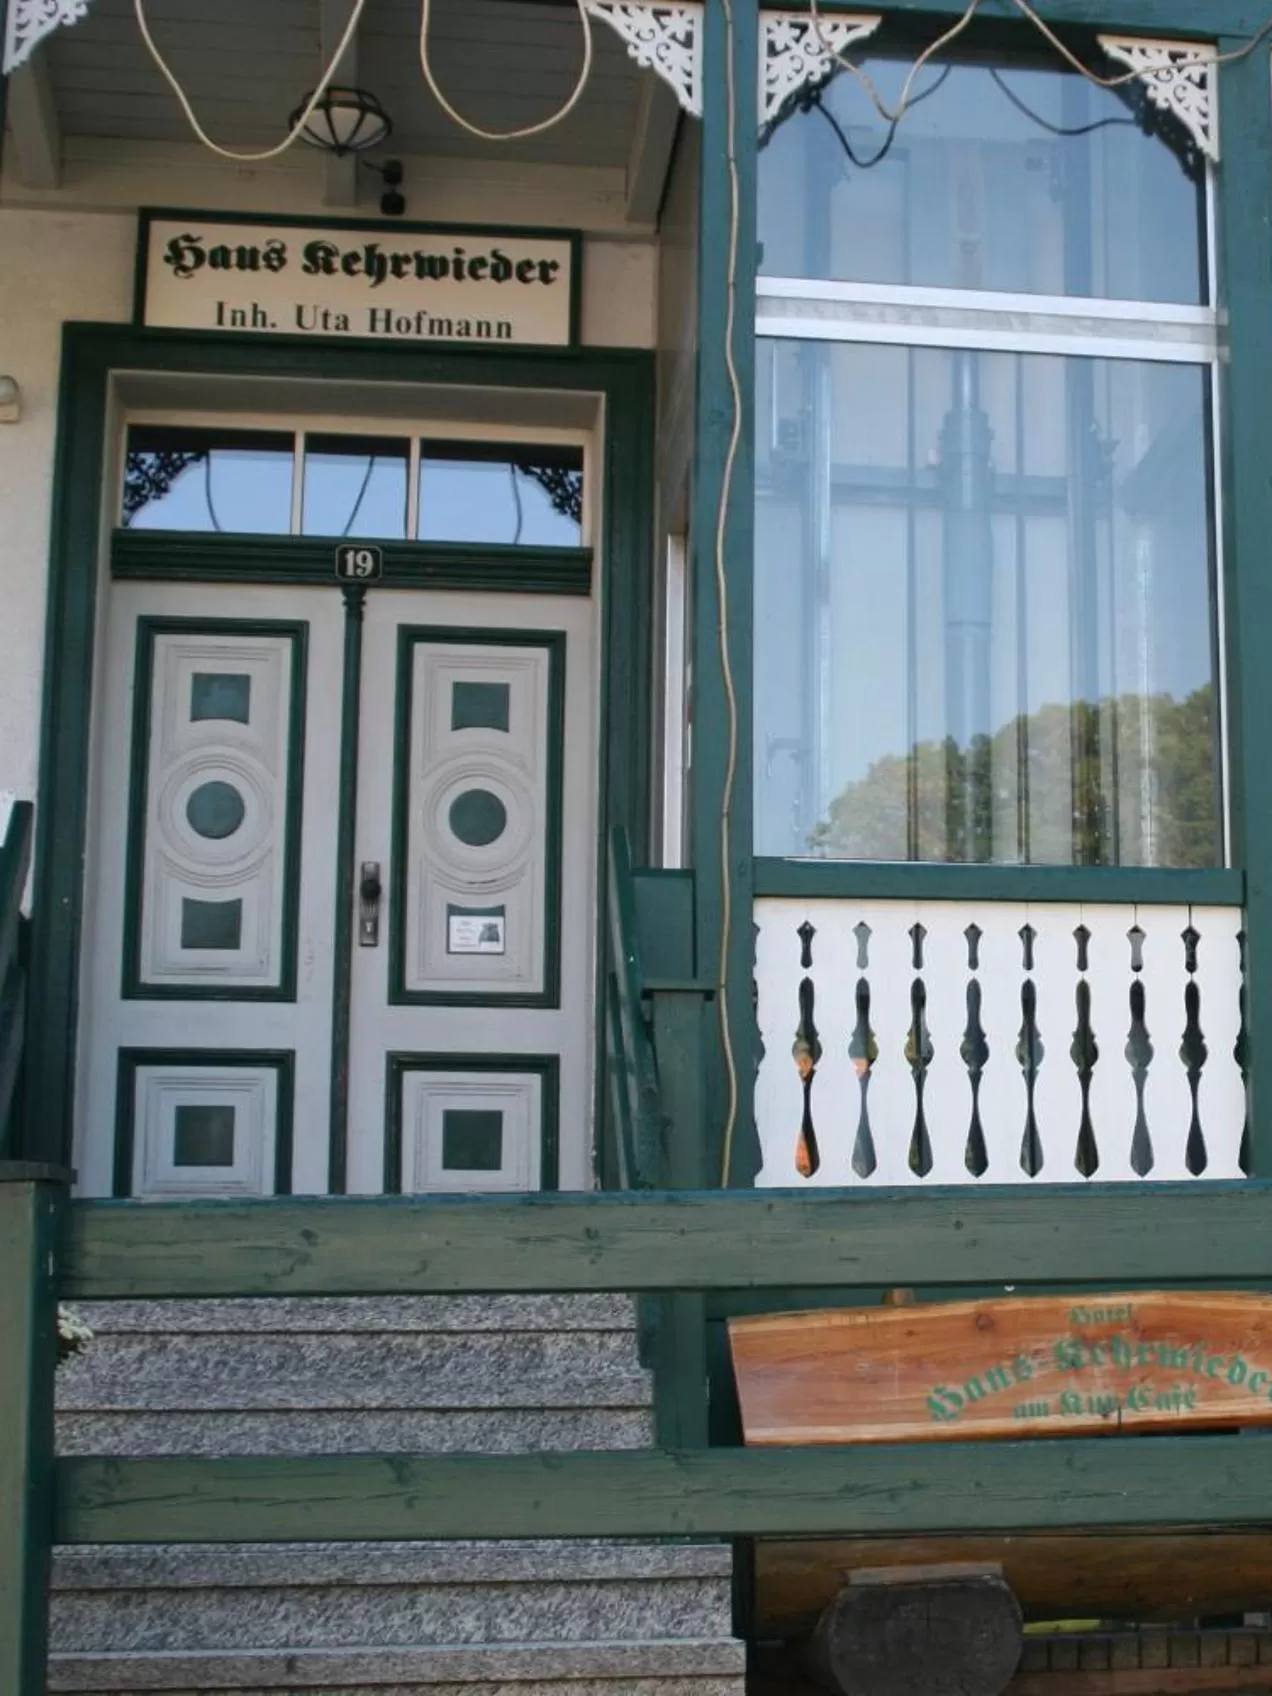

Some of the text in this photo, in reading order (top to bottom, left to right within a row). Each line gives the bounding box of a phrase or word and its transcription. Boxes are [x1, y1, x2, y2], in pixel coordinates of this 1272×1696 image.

[163, 233, 560, 288] Haus Kehrwieder
[216, 301, 512, 339] Inh. Uta Hofmann
[344, 550, 373, 577] 19
[1070, 1304, 1133, 1326] Hotel
